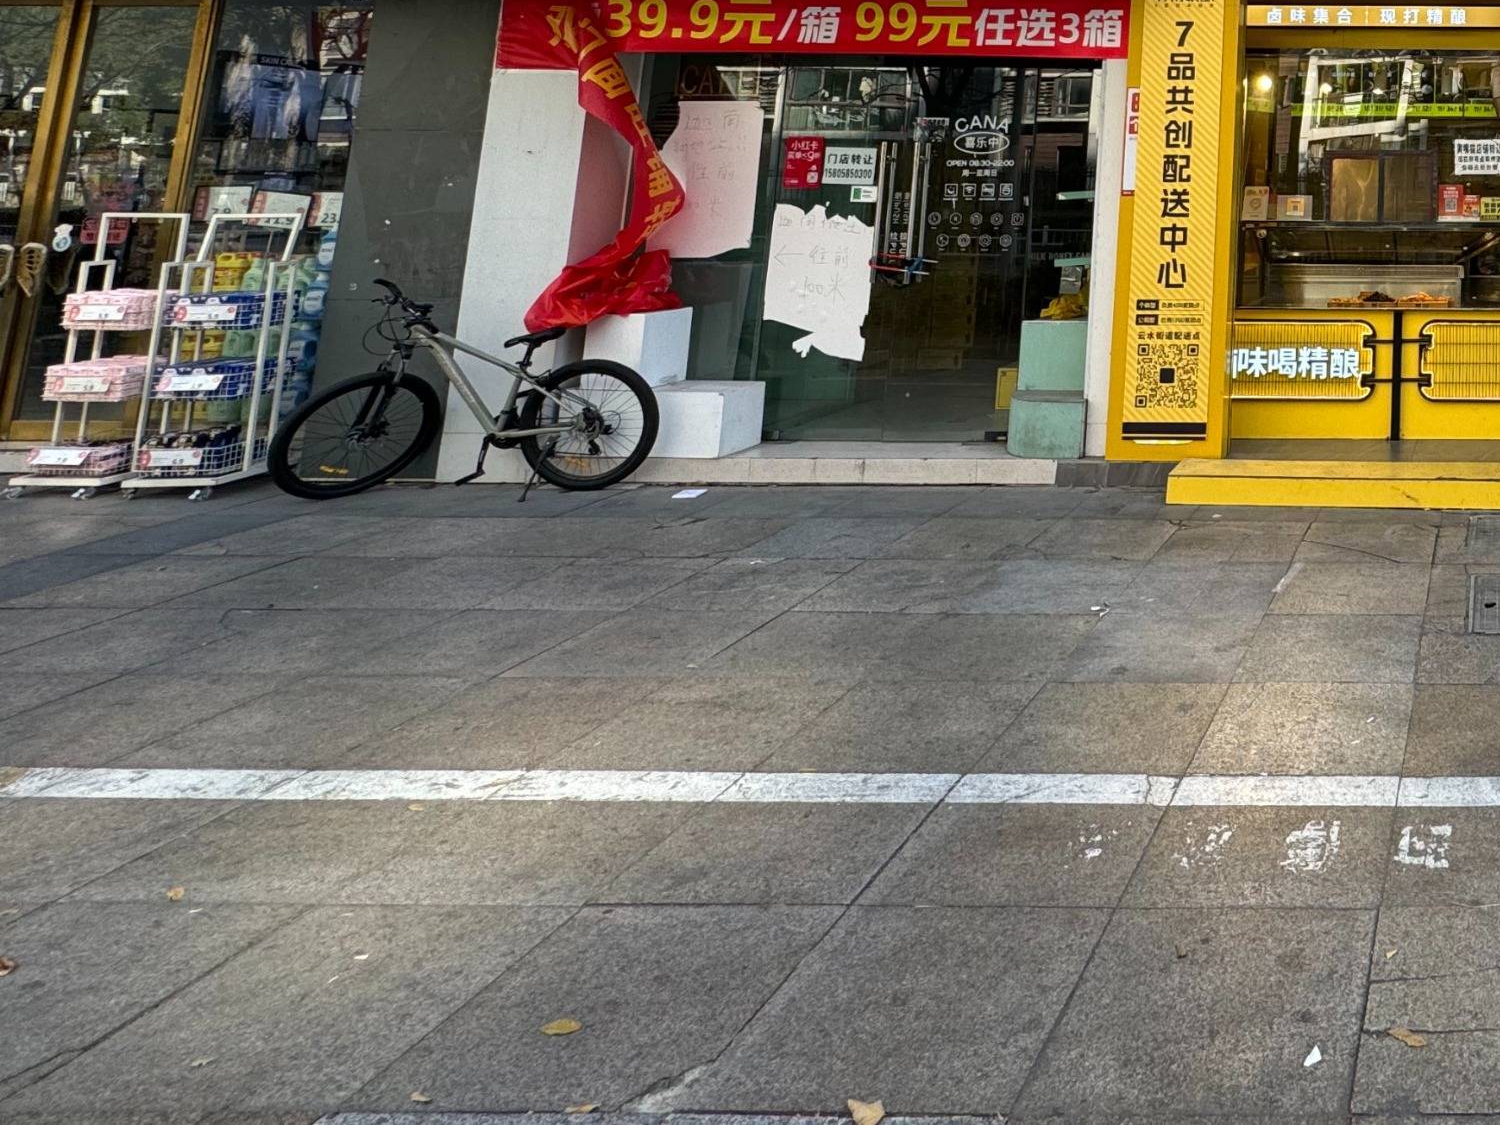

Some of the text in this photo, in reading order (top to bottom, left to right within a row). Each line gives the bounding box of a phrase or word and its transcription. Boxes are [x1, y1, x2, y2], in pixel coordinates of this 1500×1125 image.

[1267, 7, 1467, 25] 卤味集合 现打精酿
[260, 56, 279, 65] SKIN
[955, 115, 1009, 134] CANA
[791, 140, 819, 150] 小红卡
[827, 153, 873, 165] 门店转让
[1157, 21, 1195, 290] 7品共创配送中心
